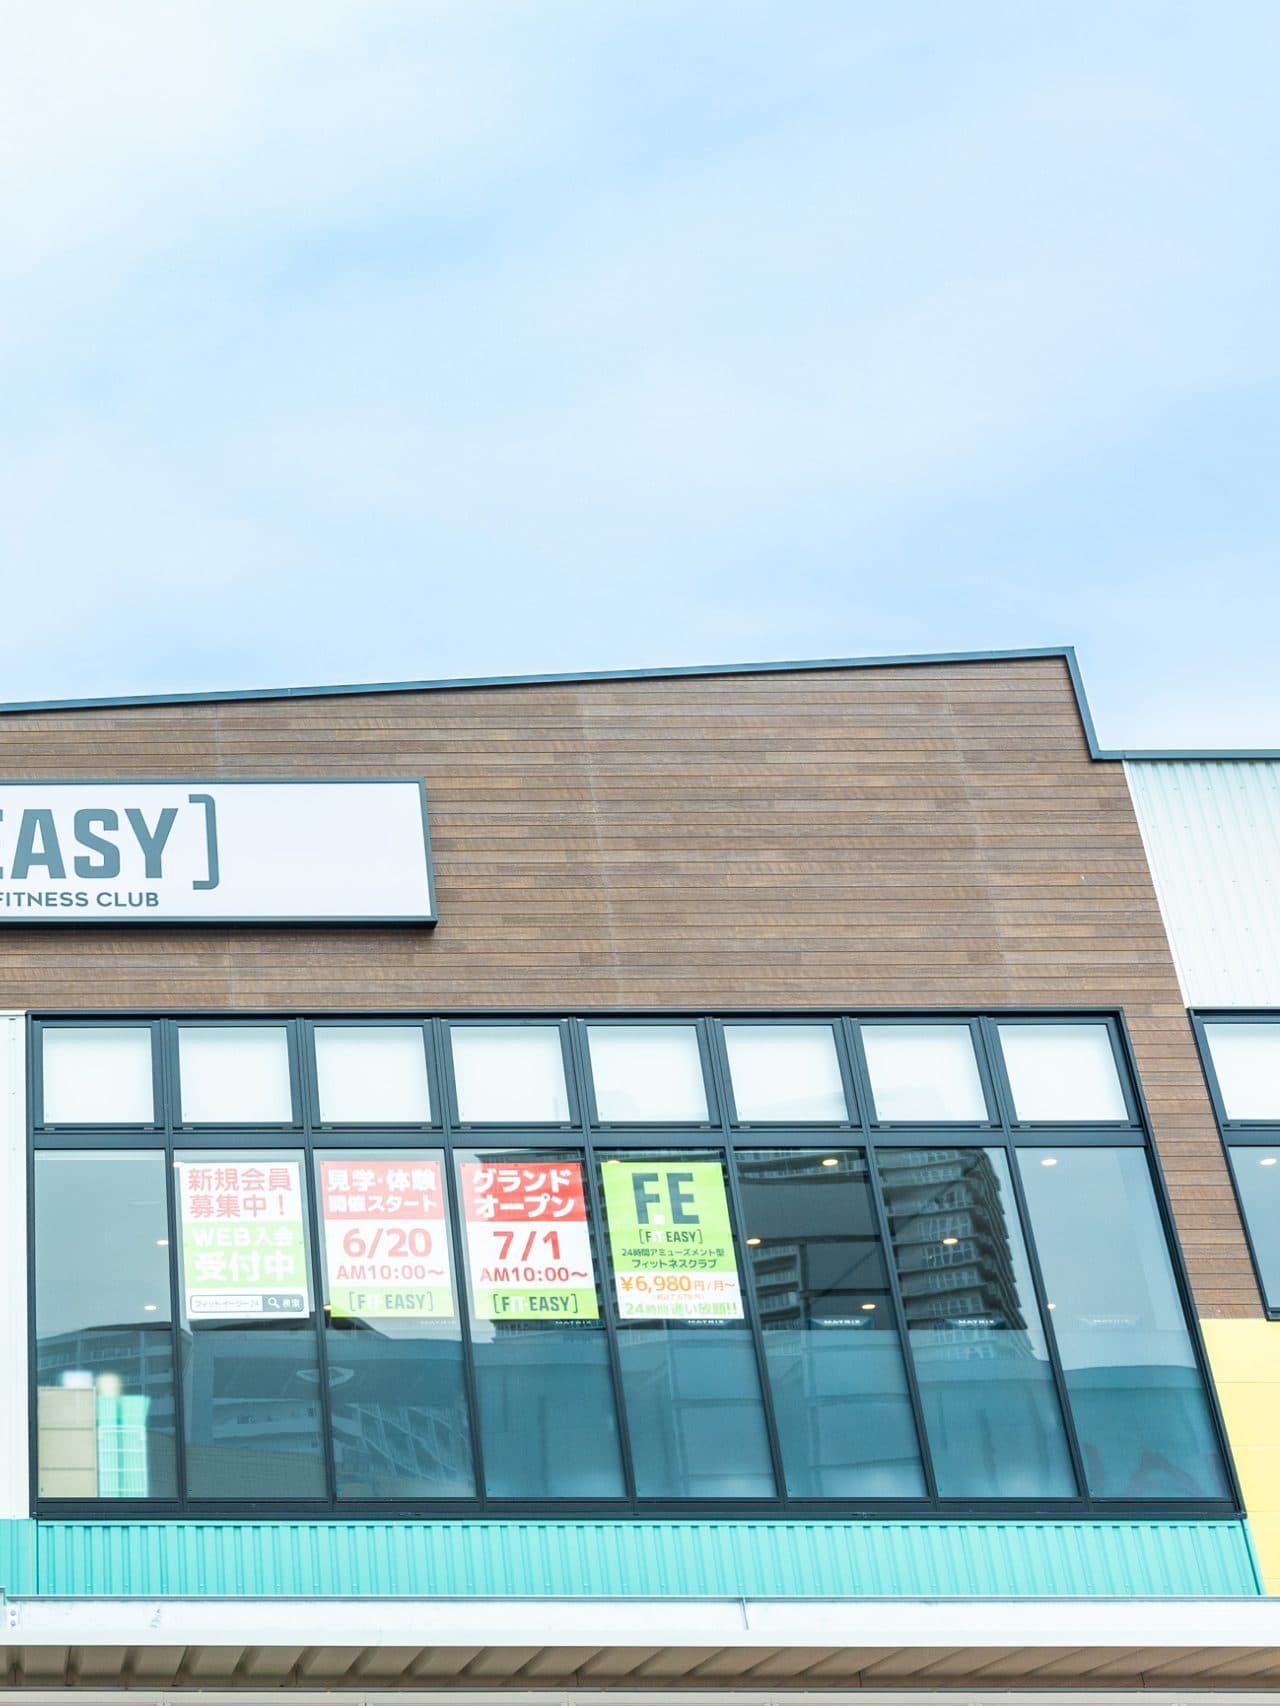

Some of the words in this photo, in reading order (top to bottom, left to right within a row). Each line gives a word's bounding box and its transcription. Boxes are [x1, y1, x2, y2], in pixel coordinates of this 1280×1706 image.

[95, 890, 160, 908] CLUB
[188, 1168, 292, 1192] 新規会員
[472, 1168, 572, 1193] グランド
[475, 1194, 576, 1218] オープン
[343, 1228, 433, 1259] 6/20
[493, 1231, 562, 1262] 7/1
[621, 1247, 725, 1257] 24時間アミューズメント型
[194, 1251, 295, 1281] 受付中
[631, 1259, 718, 1269] フィットネスクラブ
